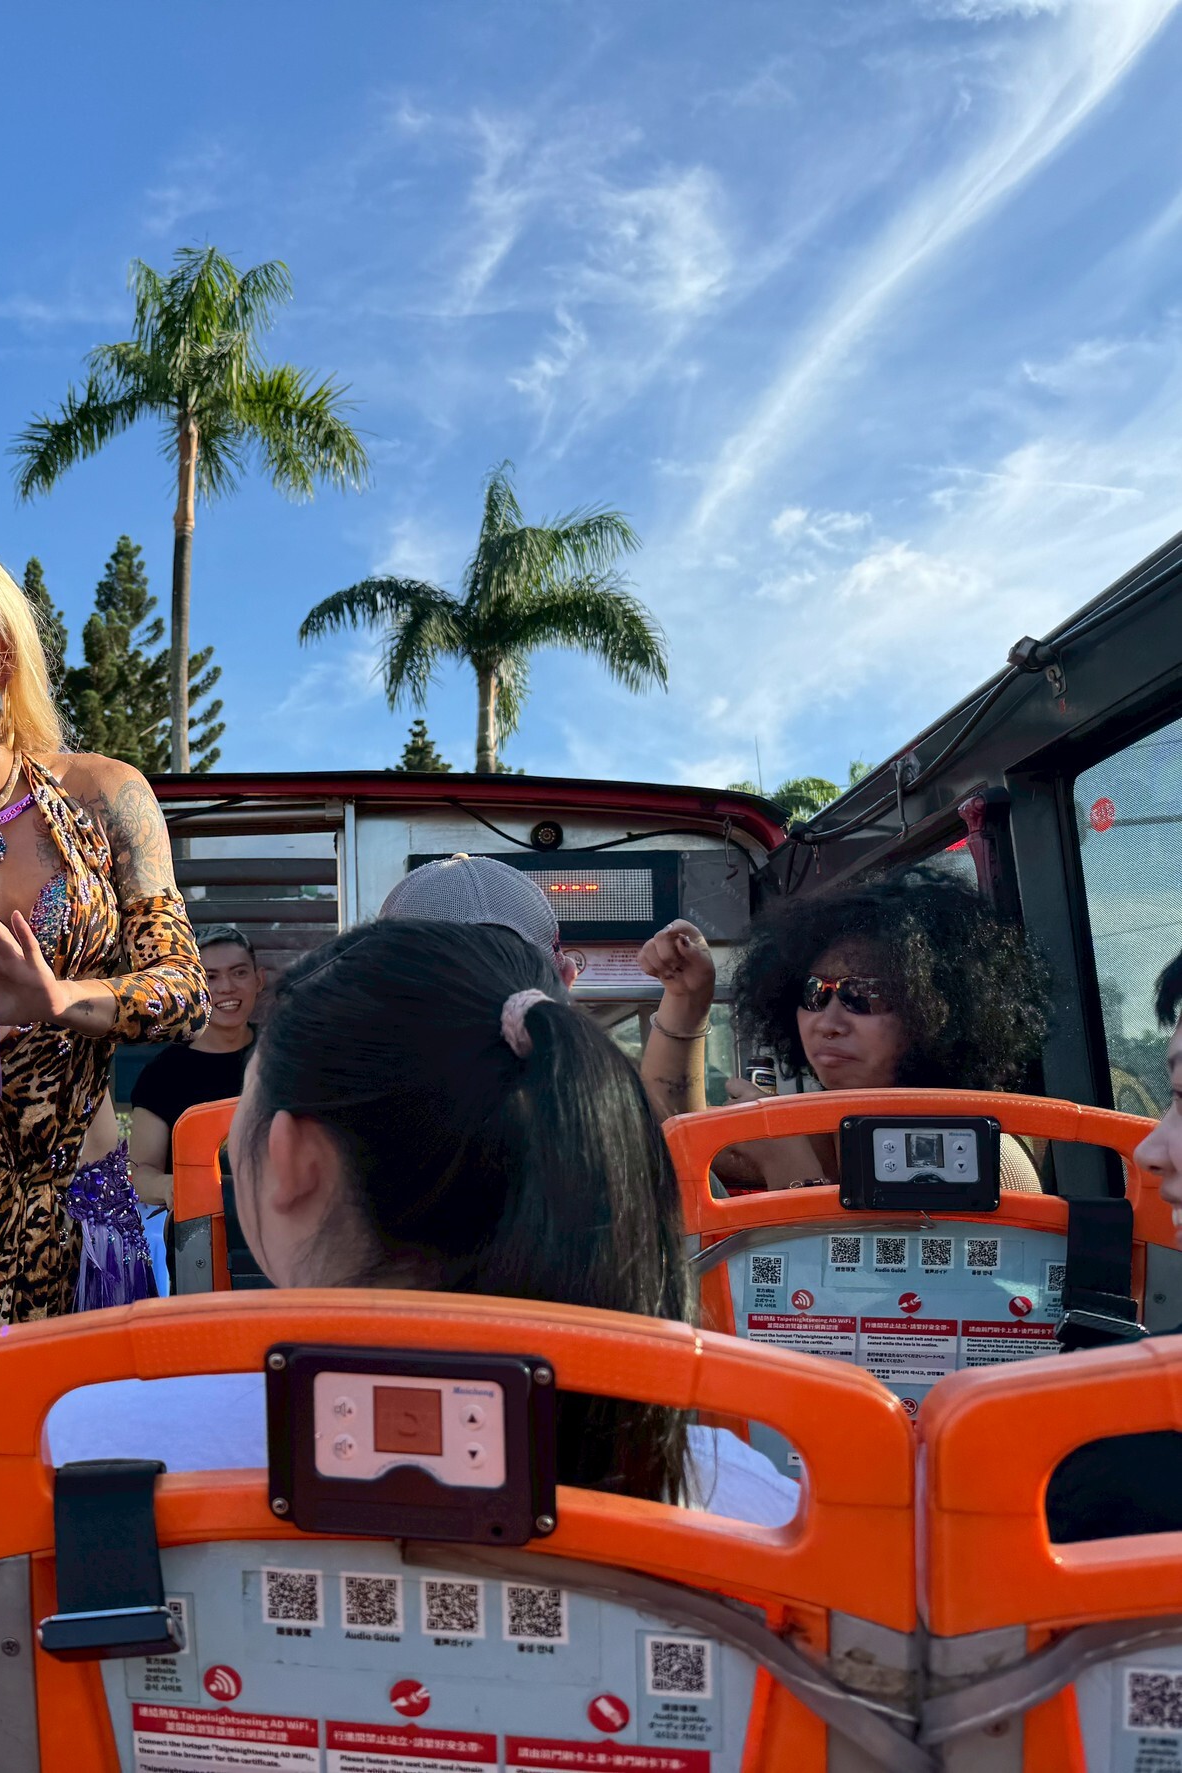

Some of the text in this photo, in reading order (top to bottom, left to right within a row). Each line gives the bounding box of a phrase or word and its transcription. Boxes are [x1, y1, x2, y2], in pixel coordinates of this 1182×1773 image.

[345, 1631, 401, 1643] Audio Guide
[181, 1711, 268, 1728] Taipeisightseeing
[270, 1719, 284, 1728] AD
[653, 1712, 679, 1720] Audio
[139, 1737, 167, 1746] Connect
[182, 1741, 209, 1750] hotspot
[184, 1751, 213, 1760] browser
[241, 1758, 281, 1767] certificate.
[340, 1754, 364, 1763] Please
[366, 1756, 389, 1764] fasten
